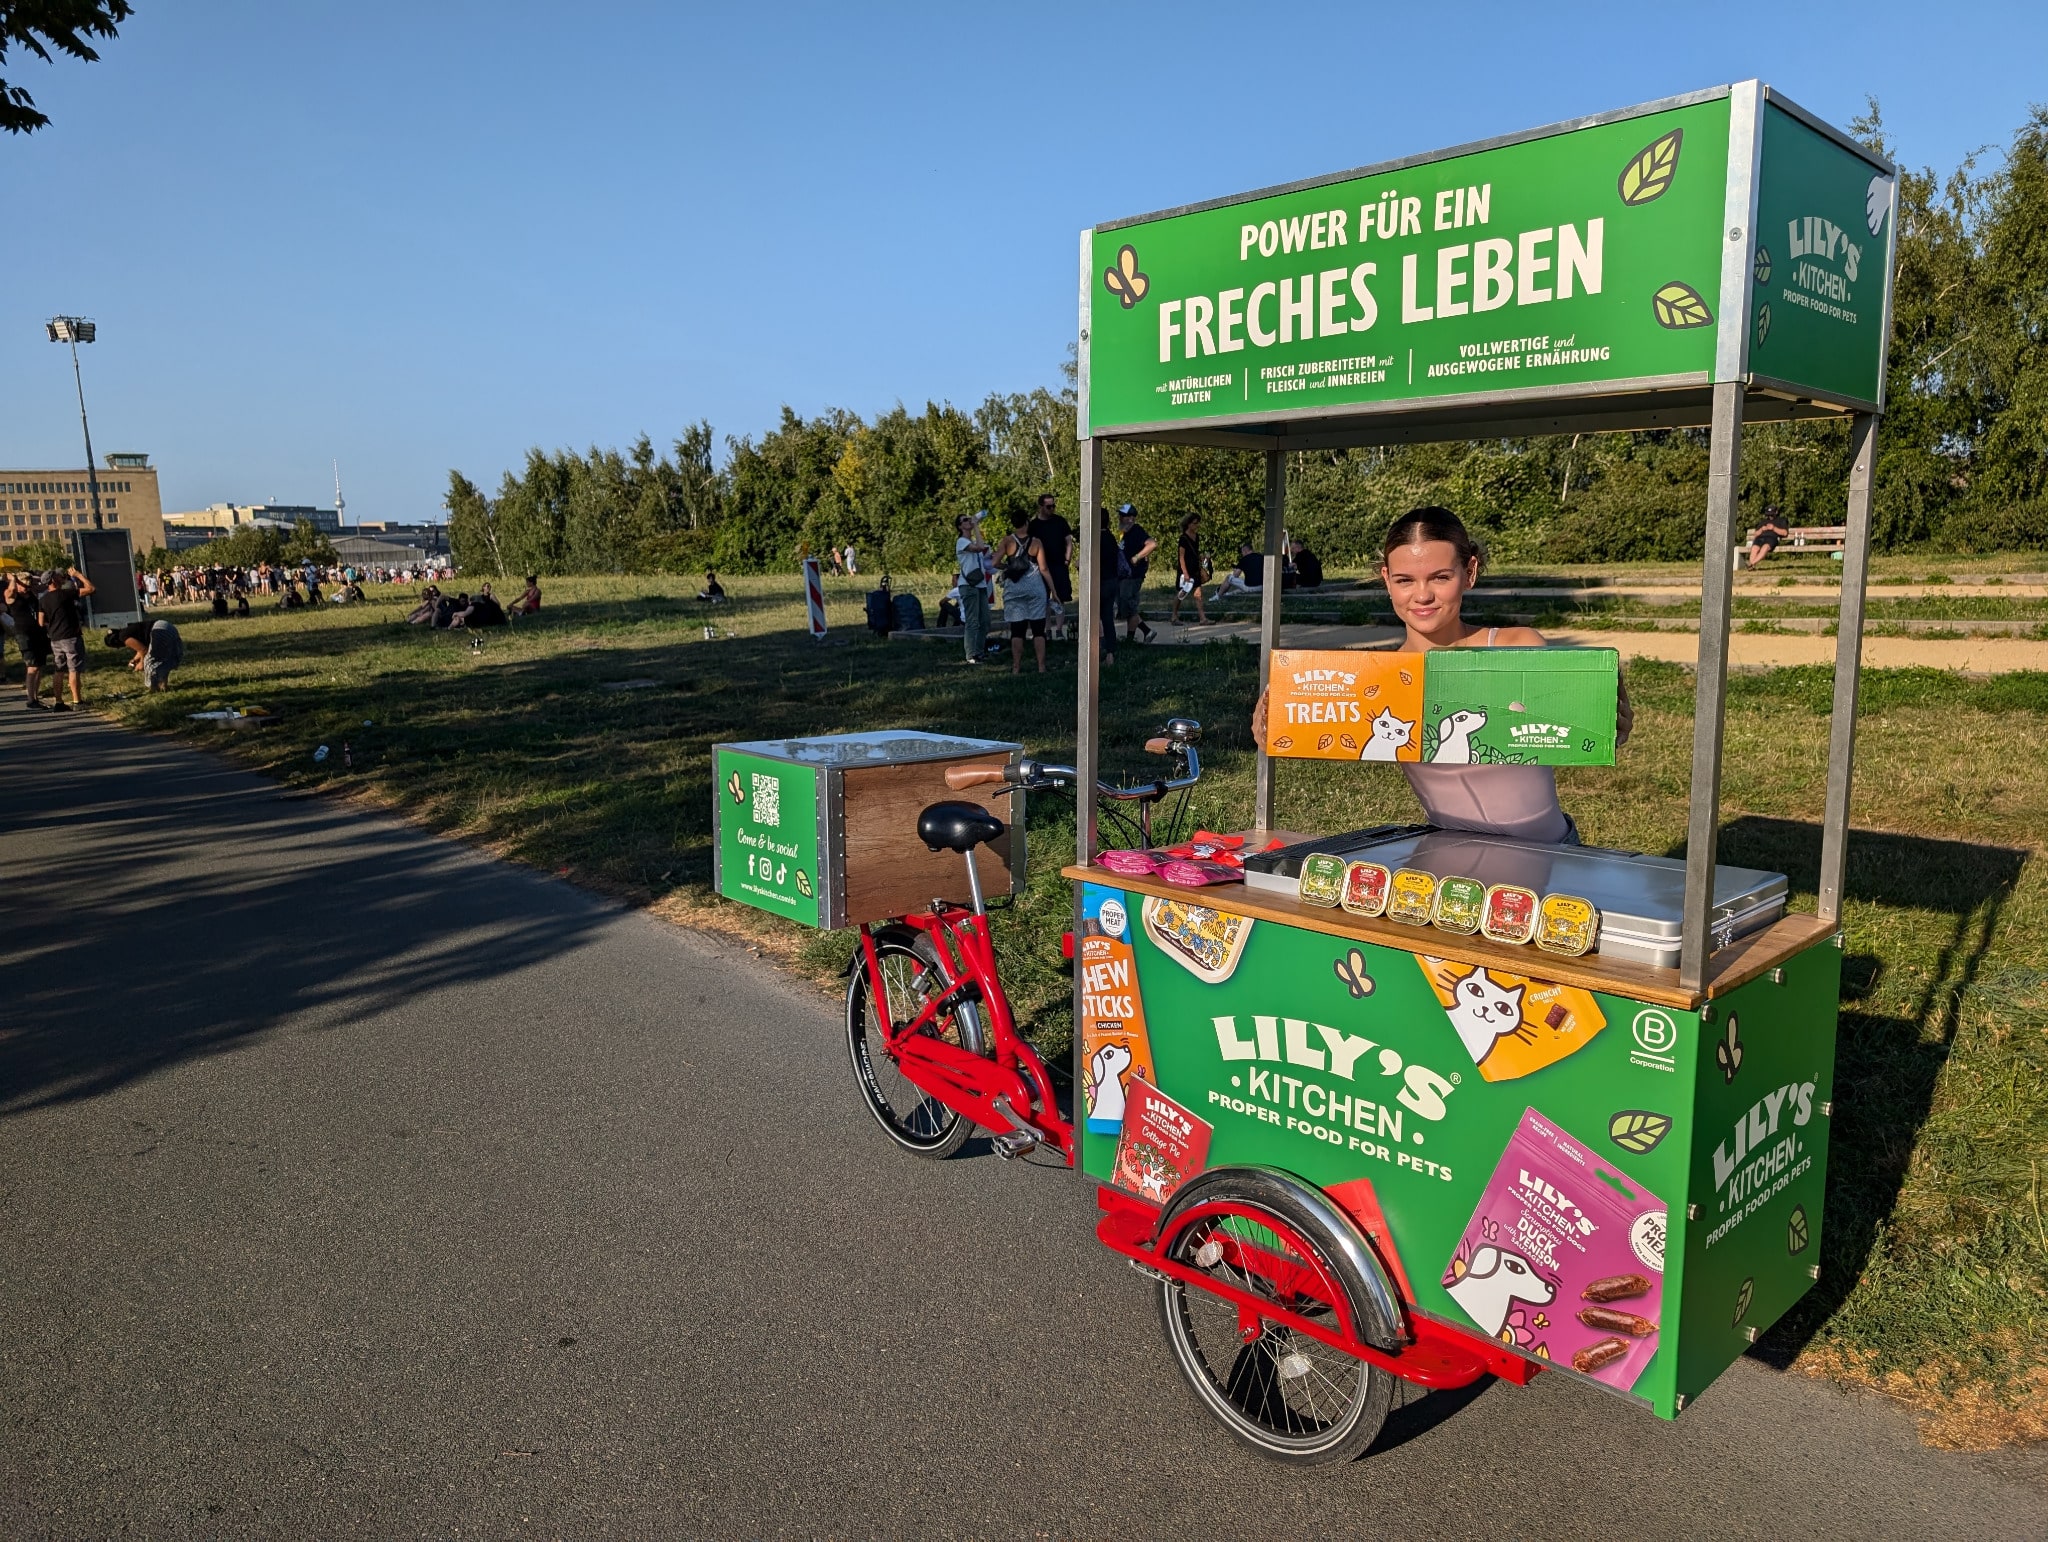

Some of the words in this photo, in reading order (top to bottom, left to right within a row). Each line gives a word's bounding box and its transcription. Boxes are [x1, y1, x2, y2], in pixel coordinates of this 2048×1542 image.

[1241, 209, 1347, 260] POWER
[1359, 190, 1421, 242] FÜR
[1434, 184, 1491, 233] EIN
[1787, 216, 1860, 282] LILY'S
[1159, 262, 1377, 363] FRECHES
[1402, 217, 1604, 325] LEBEN
[1799, 261, 1846, 303] KITCHEN
[1783, 288, 1809, 309] PROPER
[1810, 298, 1828, 314] FOOD
[1828, 305, 1842, 319] FOR
[1842, 310, 1857, 324] PETS
[1459, 335, 1549, 358] VOLLWERTIGE
[1553, 333, 1575, 348] und
[1260, 364, 1295, 379] FRISCH
[1298, 356, 1376, 376] ZUBEREITETEM
[1379, 354, 1394, 367] mit
[1427, 355, 1521, 377] AUSGEWOGENE
[1526, 346, 1610, 369] ERNÄHRUNG
[1155, 383, 1168, 393] mit
[1168, 373, 1232, 392] NATÜRLICHEN
[1266, 377, 1306, 393] FLEISCH
[1309, 376, 1326, 389] und
[1327, 370, 1386, 387] INNEREIEN
[1171, 390, 1211, 405] ZUTATEN
[1293, 669, 1357, 685] LILY'S
[1303, 683, 1345, 691] KITCHEN
[1284, 701, 1361, 724] TREATS
[1510, 723, 1569, 738] LILY'S
[1520, 736, 1559, 744] KITCHEN
[737, 827, 757, 847] Come
[758, 833, 766, 849] &
[767, 836, 775, 852] be
[776, 843, 799, 859] social
[1102, 909, 1125, 920] PROPER
[1105, 917, 1121, 926] MEAT
[1529, 986, 1562, 1003] CRUNCHY
[1644, 1016, 1665, 1044] B
[1629, 1056, 1675, 1073] Corporation
[1146, 1096, 1192, 1135] LILY'S
[1249, 1066, 1403, 1143] KITCHEN
[1150, 1111, 1183, 1139] KITCHEN
[1208, 1090, 1281, 1126] PROPER
[1286, 1116, 1343, 1145] FOOD
[1349, 1136, 1391, 1163] FOR
[1397, 1151, 1453, 1182] PETS
[1529, 1116, 1555, 1138] GRAIN-FREE
[1532, 1124, 1547, 1138] RECIPE
[1712, 1082, 1815, 1193] LILY'S
[1142, 1125, 1168, 1150] Cottage
[1168, 1142, 1181, 1159] Pie
[1556, 1143, 1586, 1167] INGREDIENTS
[1562, 1141, 1584, 1160] NATURAL
[1728, 1132, 1796, 1210] KITCHEN
[1519, 1168, 1597, 1236] LILY'S
[1525, 1188, 1576, 1235] KITCHEN
[1706, 1209, 1743, 1250] PROPER
[1745, 1189, 1771, 1218] FOOD
[1771, 1174, 1790, 1197] FOR
[1790, 1155, 1812, 1182] PETS
[1507, 1185, 1533, 1210] PROPER
[1532, 1207, 1552, 1225] FOOD
[1552, 1223, 1566, 1238] FOR
[1566, 1235, 1587, 1253] DOGS
[1520, 1208, 1563, 1246] Scrumptious
[1503, 1223, 1517, 1238] with
[1518, 1232, 1561, 1272] VENISON
[1517, 1216, 1557, 1256] DUCK
[1510, 1237, 1544, 1267] SAUSAGES
